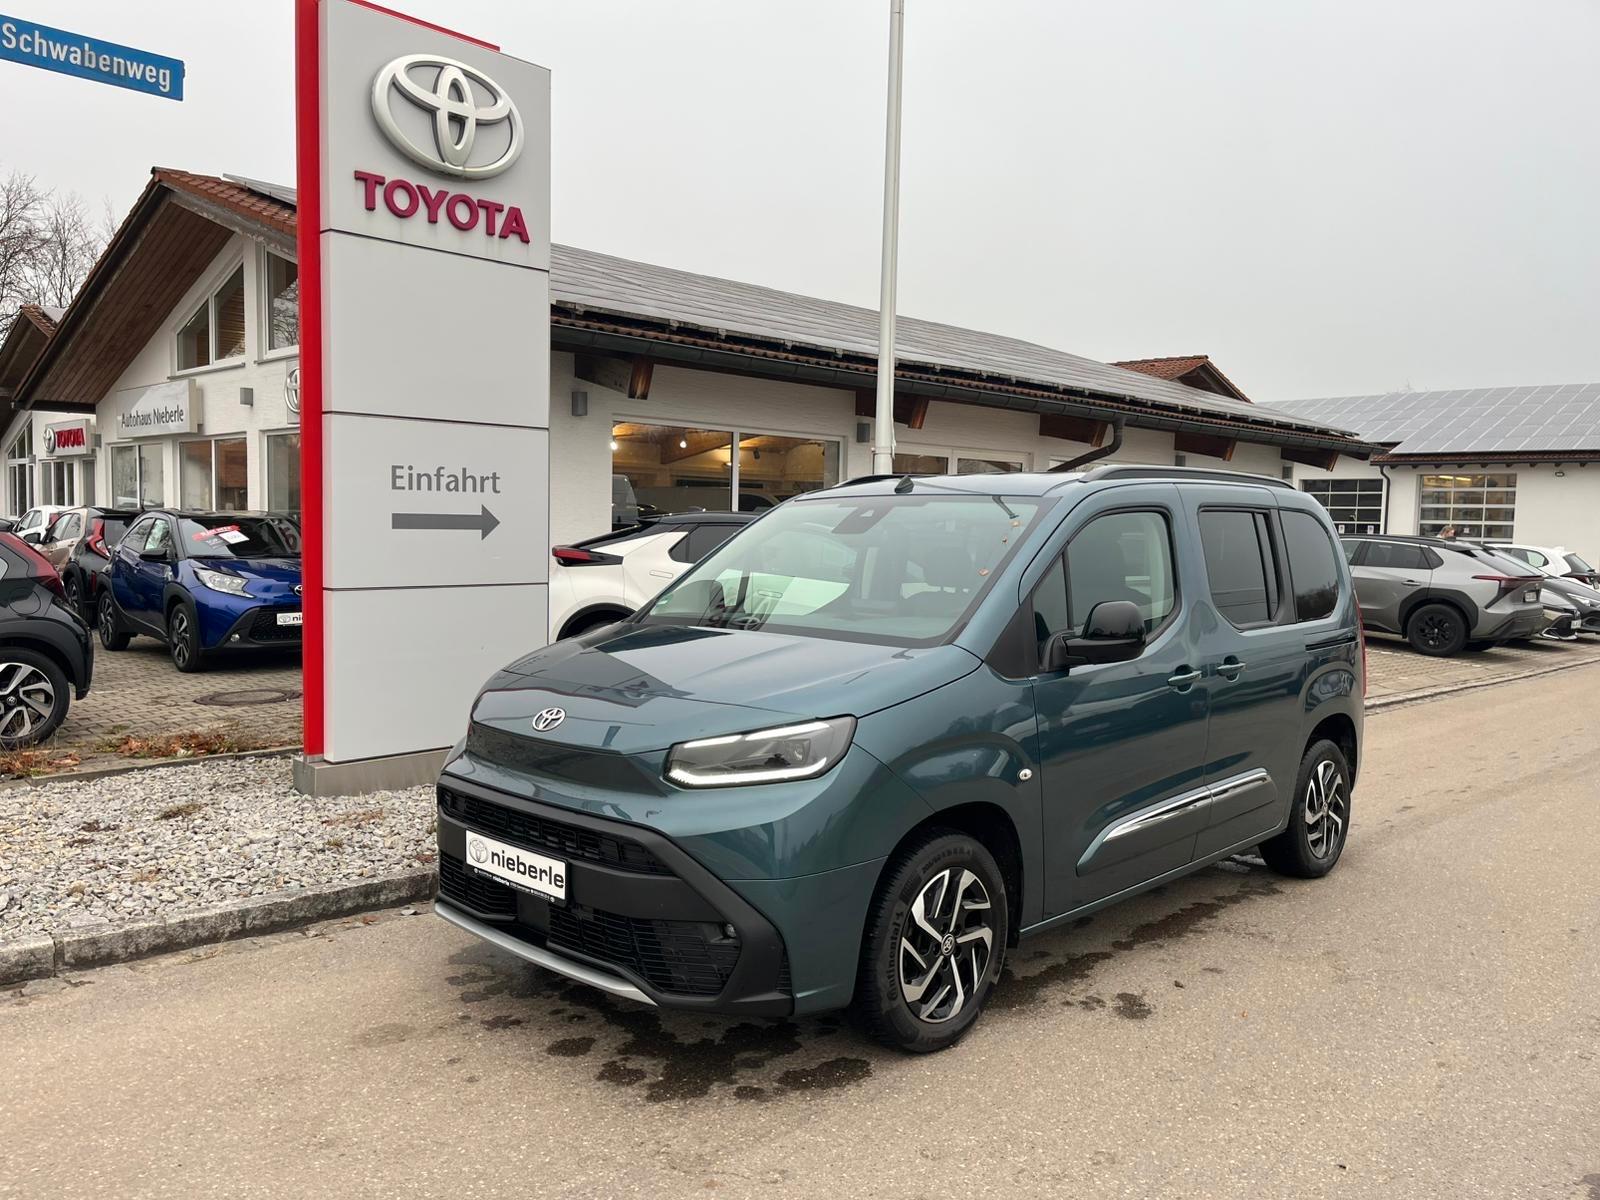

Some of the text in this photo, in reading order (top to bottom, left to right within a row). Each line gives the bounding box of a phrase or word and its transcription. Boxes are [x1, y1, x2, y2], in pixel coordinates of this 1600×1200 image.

[2, 23, 170, 92] Schwabenweg
[354, 170, 530, 244] TOYOTA
[121, 405, 184, 428] Autohaus Nieberle
[55, 428, 85, 448] TOYOTA
[391, 465, 501, 494] Einfahrt
[491, 850, 564, 888] nieberle
